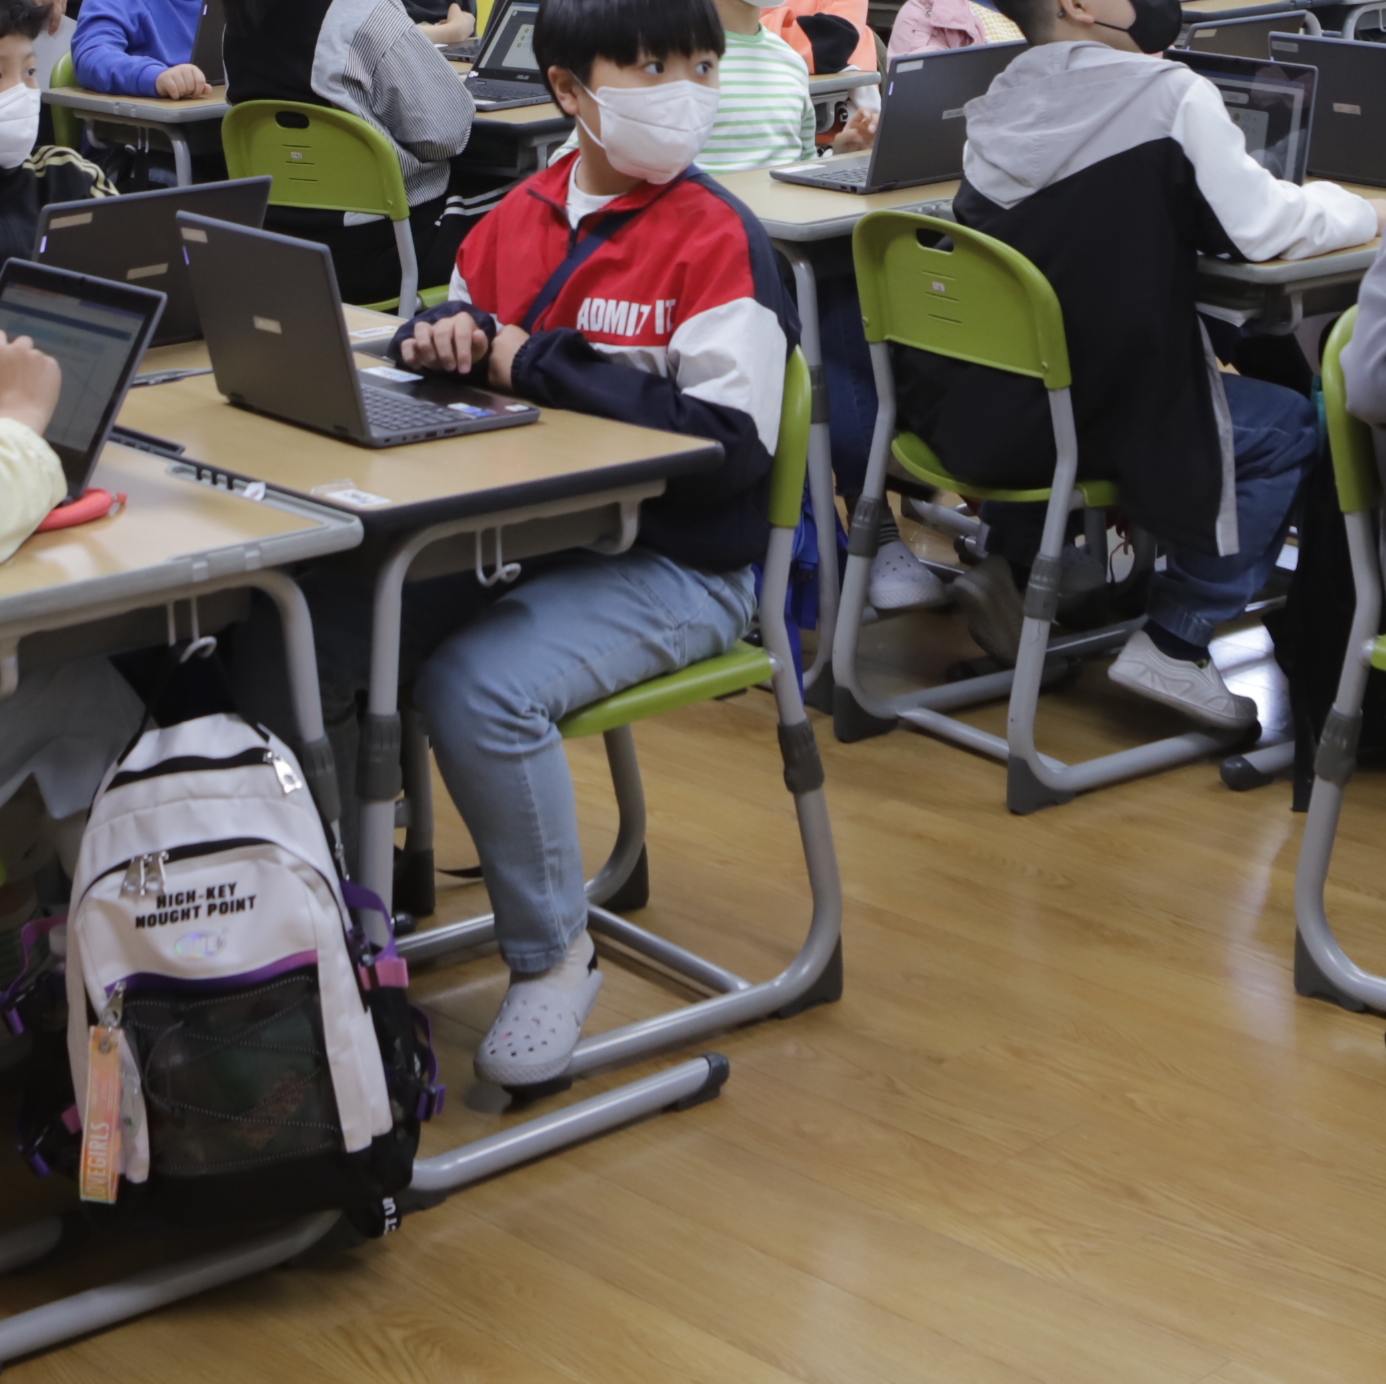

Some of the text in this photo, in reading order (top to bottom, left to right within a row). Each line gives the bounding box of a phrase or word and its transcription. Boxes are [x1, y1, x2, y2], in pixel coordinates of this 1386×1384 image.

[655, 298, 677, 335] IT
[156, 881, 238, 910] HIGH-KEY
[206, 894, 258, 918] POINT
